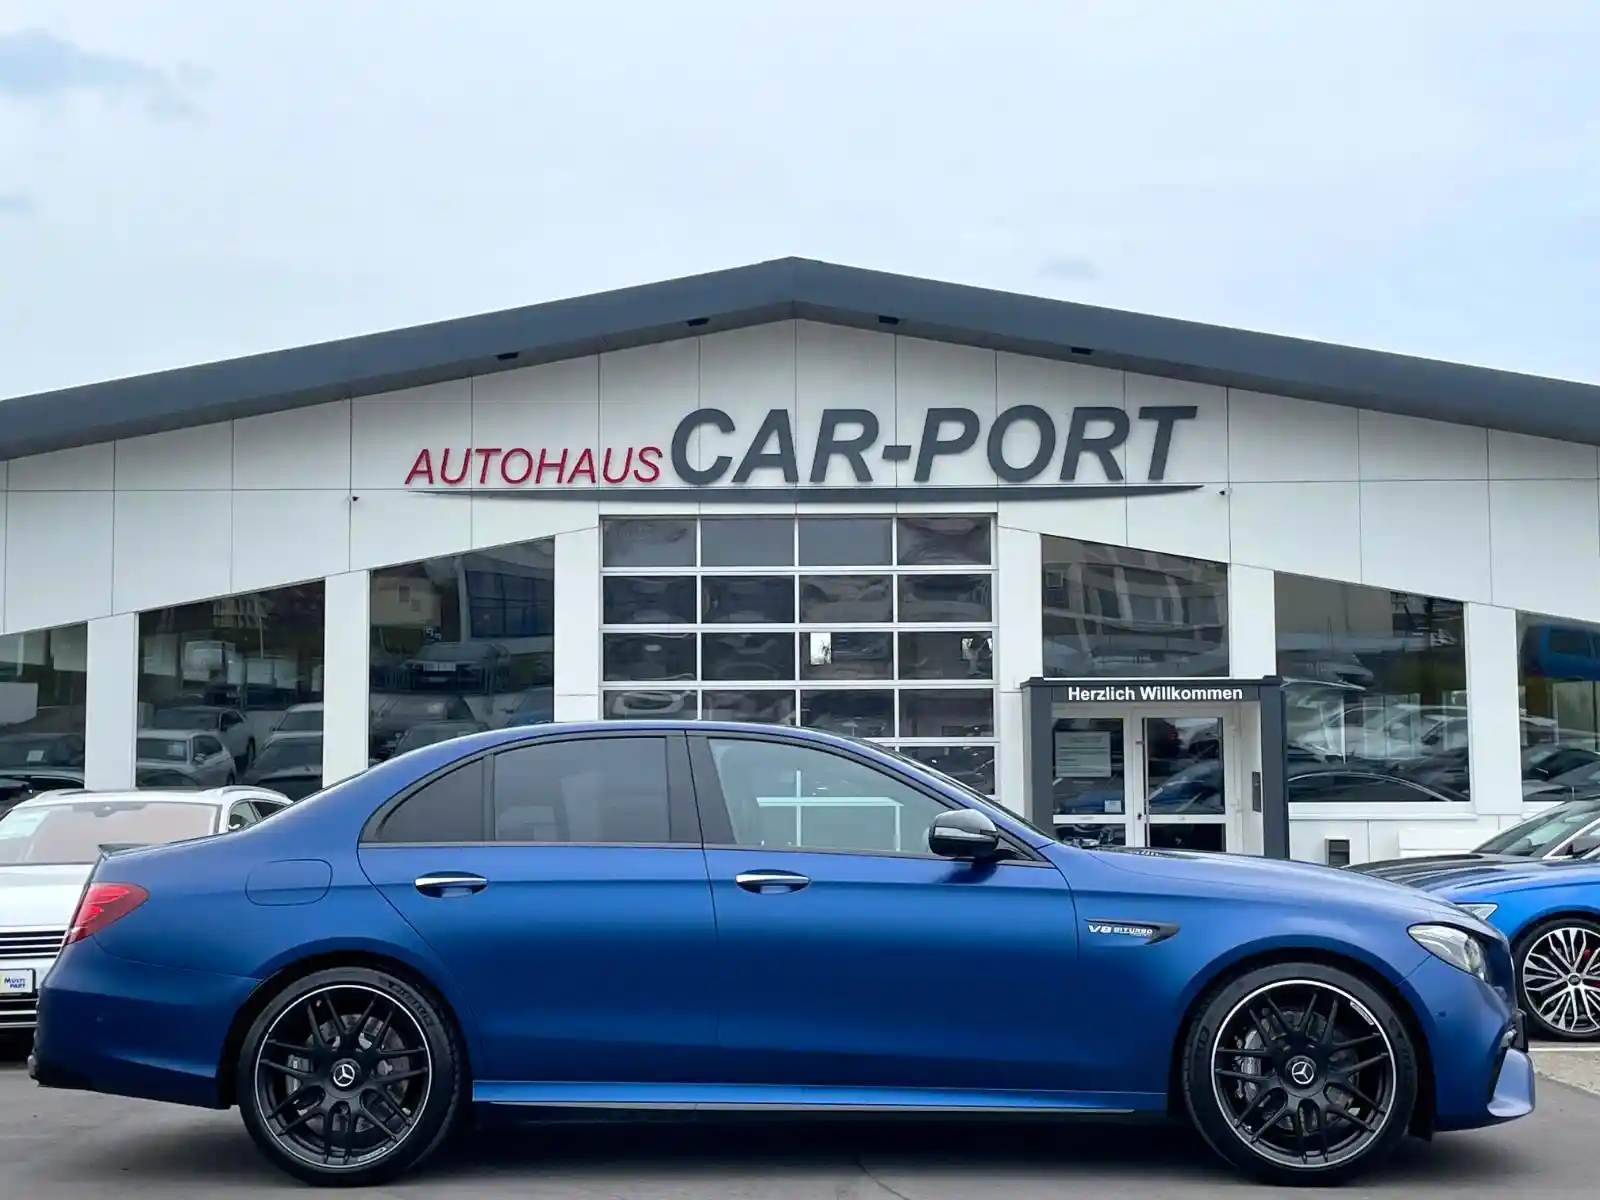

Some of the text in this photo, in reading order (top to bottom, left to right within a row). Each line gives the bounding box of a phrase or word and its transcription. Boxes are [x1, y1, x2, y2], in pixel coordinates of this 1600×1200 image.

[405, 404, 1198, 485] AUTOHAUS CAR-PORT
[1068, 686, 1243, 700] Herzlich Willkommen
[1088, 925, 1153, 935] V8 BITURBO
